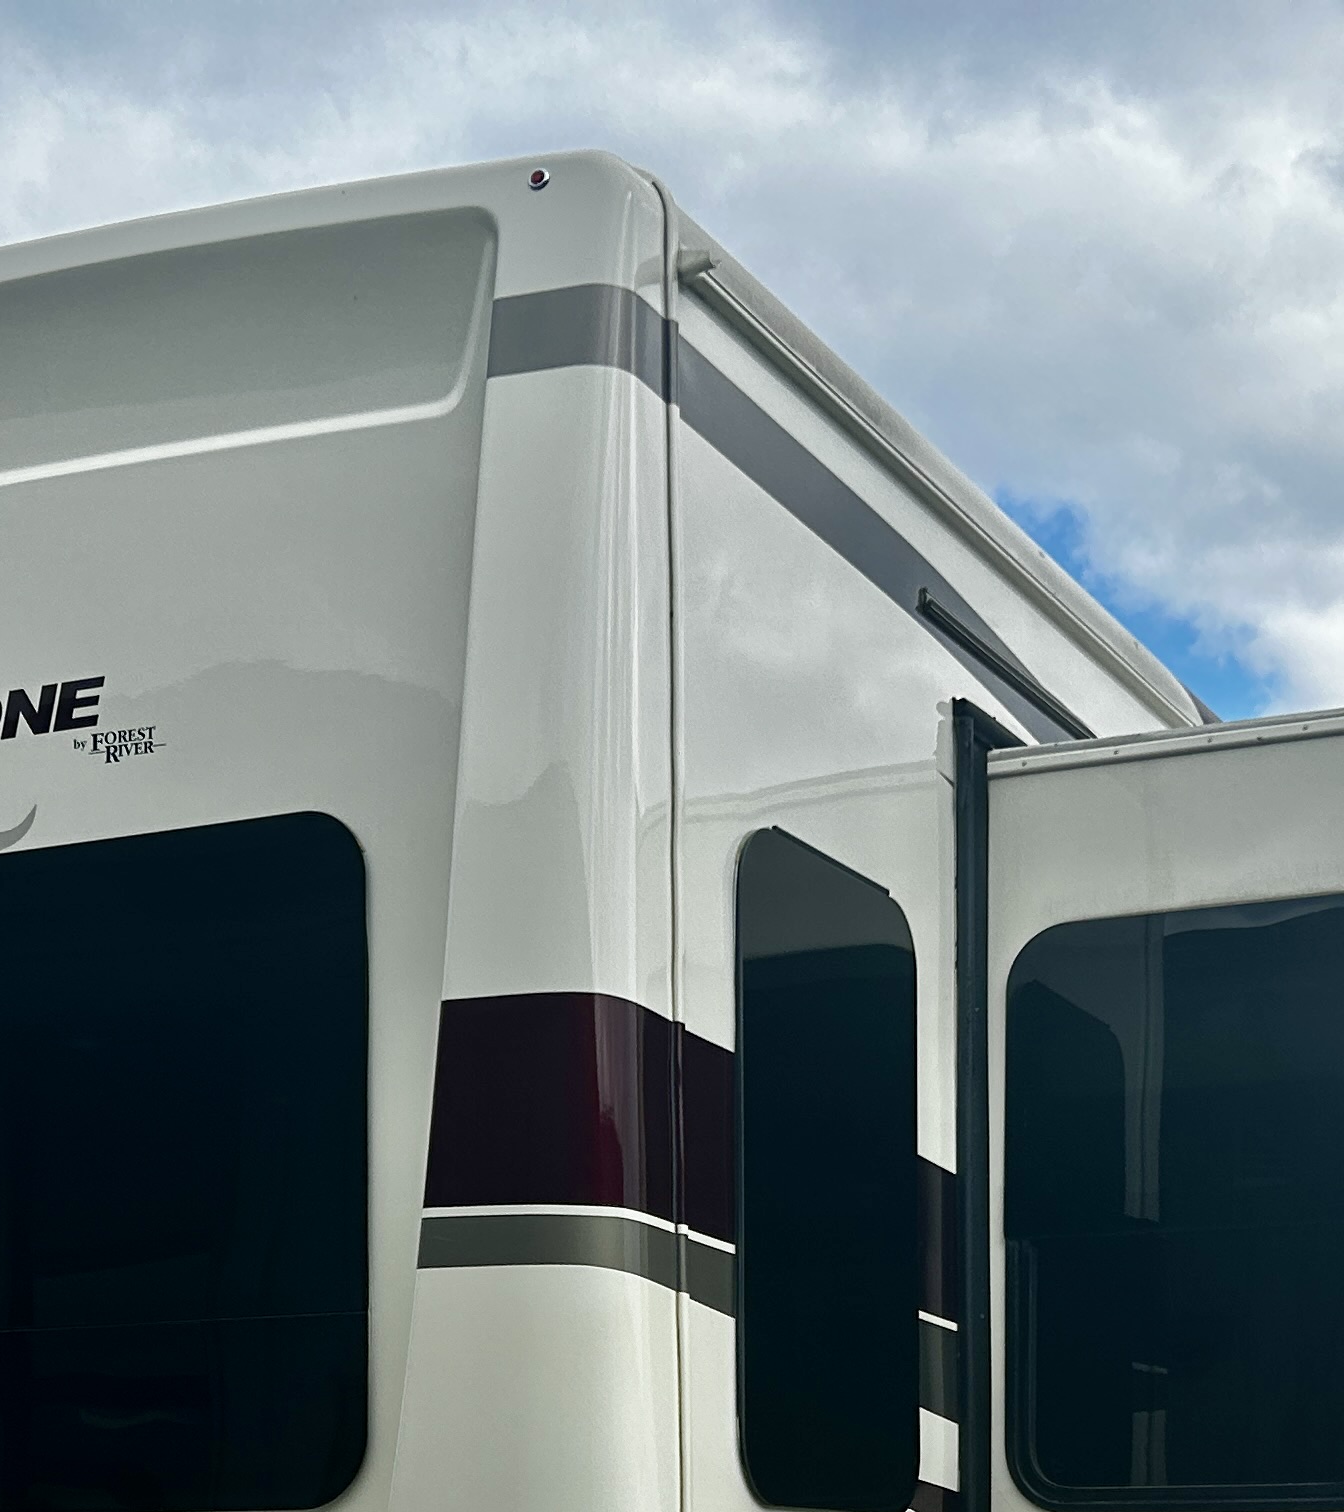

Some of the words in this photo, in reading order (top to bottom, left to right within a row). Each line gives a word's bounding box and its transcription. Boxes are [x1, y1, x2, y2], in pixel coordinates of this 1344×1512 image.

[73, 738, 87, 751] by
[91, 726, 156, 752] FOREST
[105, 740, 155, 764] RIVER
